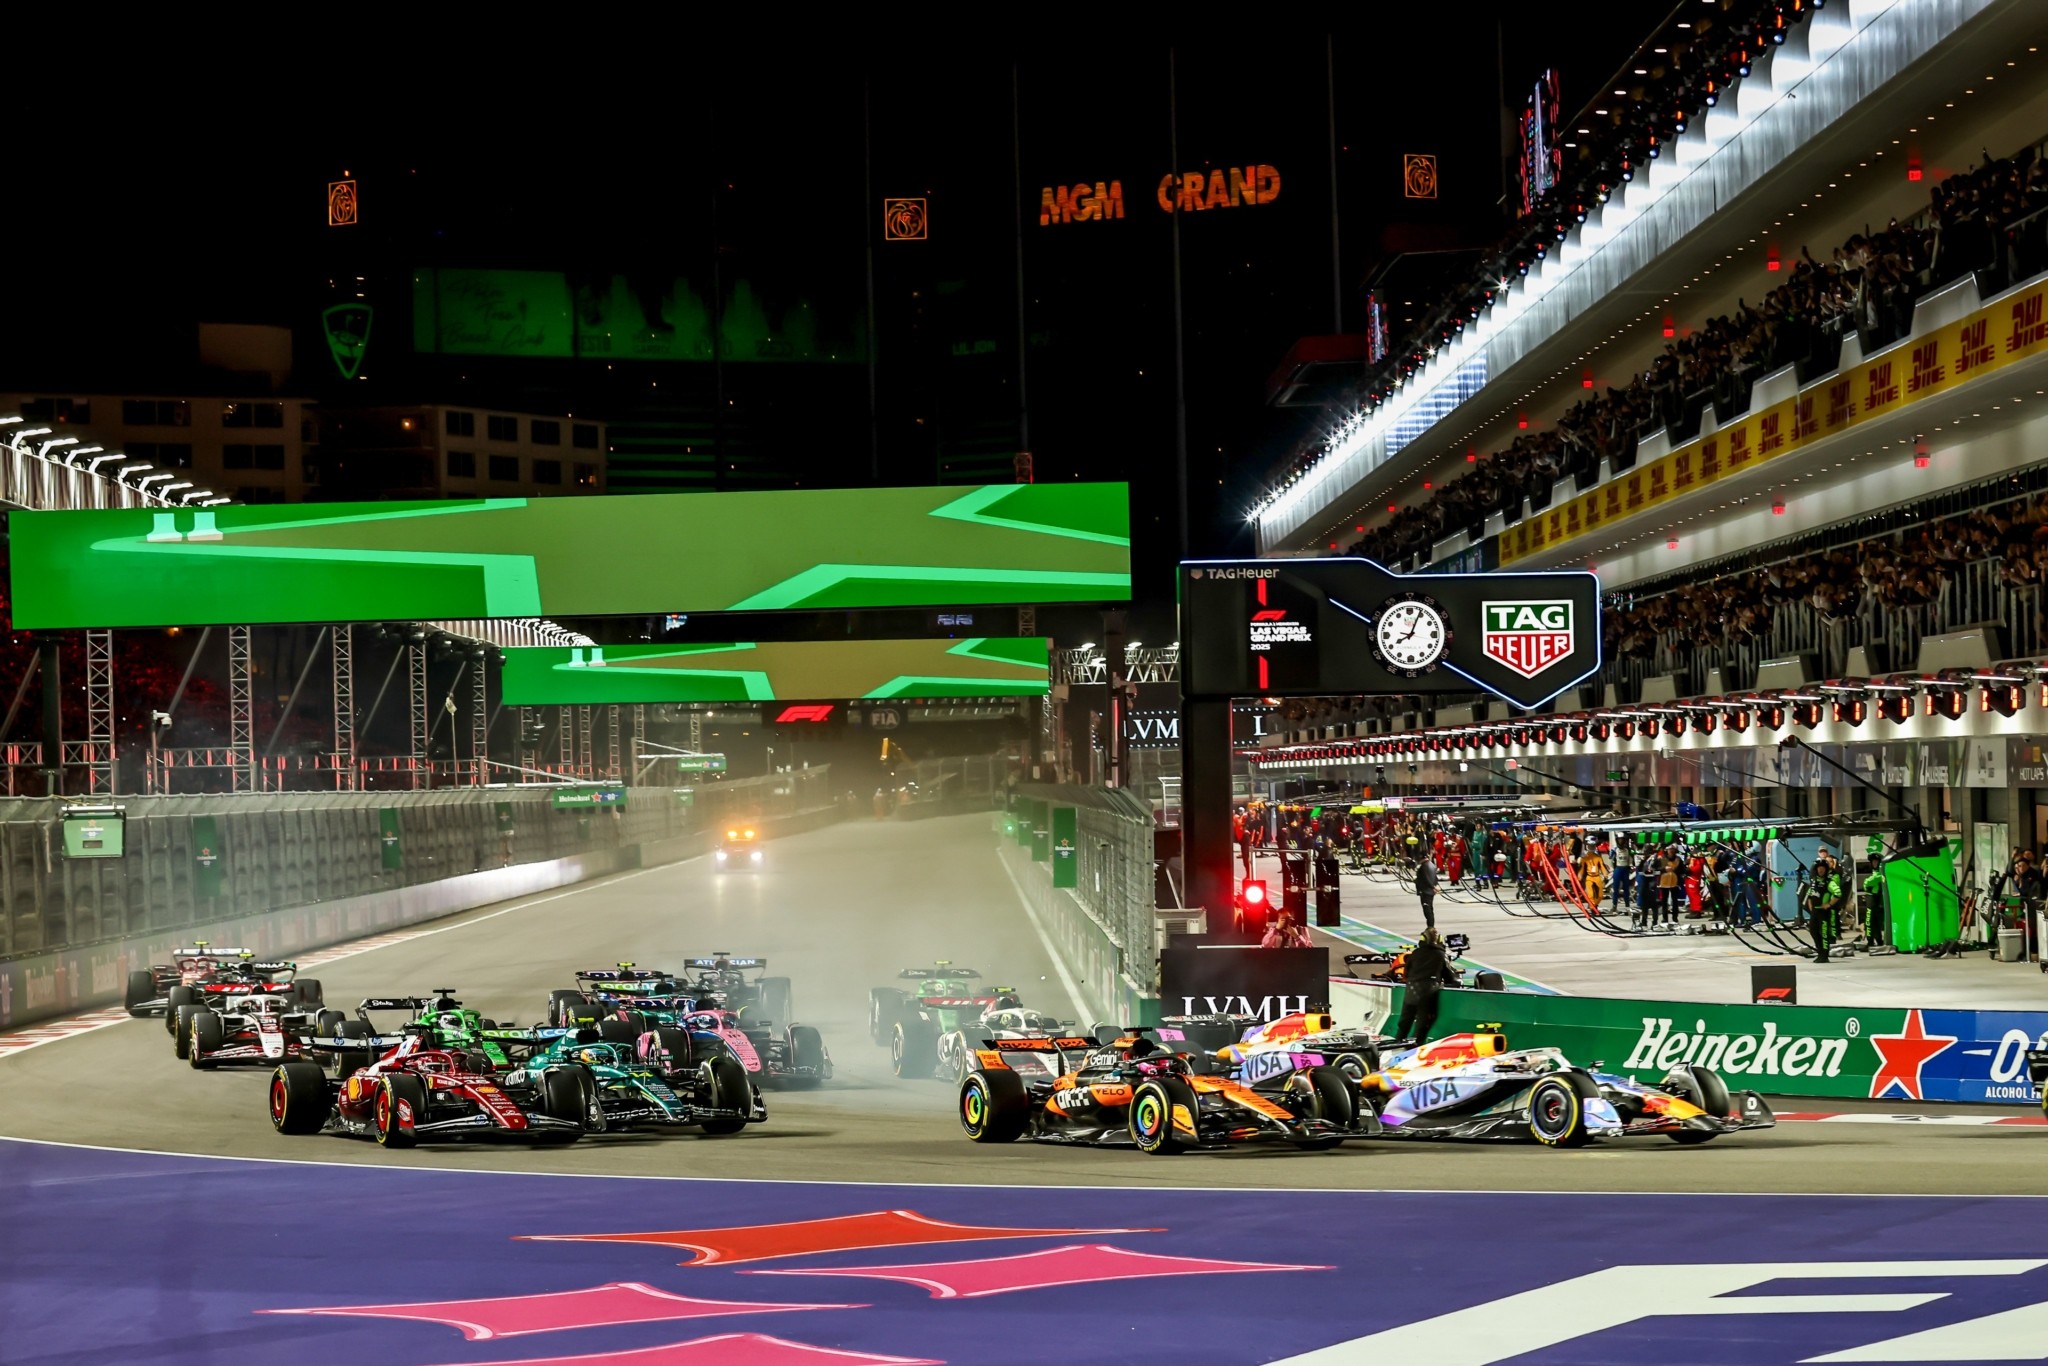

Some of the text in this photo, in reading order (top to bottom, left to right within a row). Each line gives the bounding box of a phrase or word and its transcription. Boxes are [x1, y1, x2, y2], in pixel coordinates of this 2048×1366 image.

[1040, 164, 1281, 226] MGM GRAND
[1490, 605, 1566, 630] TAG
[1250, 626, 1307, 635] LAS VEGAS
[1250, 634, 1311, 642] GRAND PRIX
[1489, 635, 1568, 674] HEUER
[872, 713, 897, 726] FIA
[2020, 767, 2044, 781] HOT LAPS
[1090, 1050, 1118, 1066] Gemini
[1246, 1052, 1282, 1081] VISA
[1096, 1088, 1126, 1097] VELO
[1410, 1077, 1460, 1110] VISA
[1985, 1086, 2028, 1099] ALCOHOL
